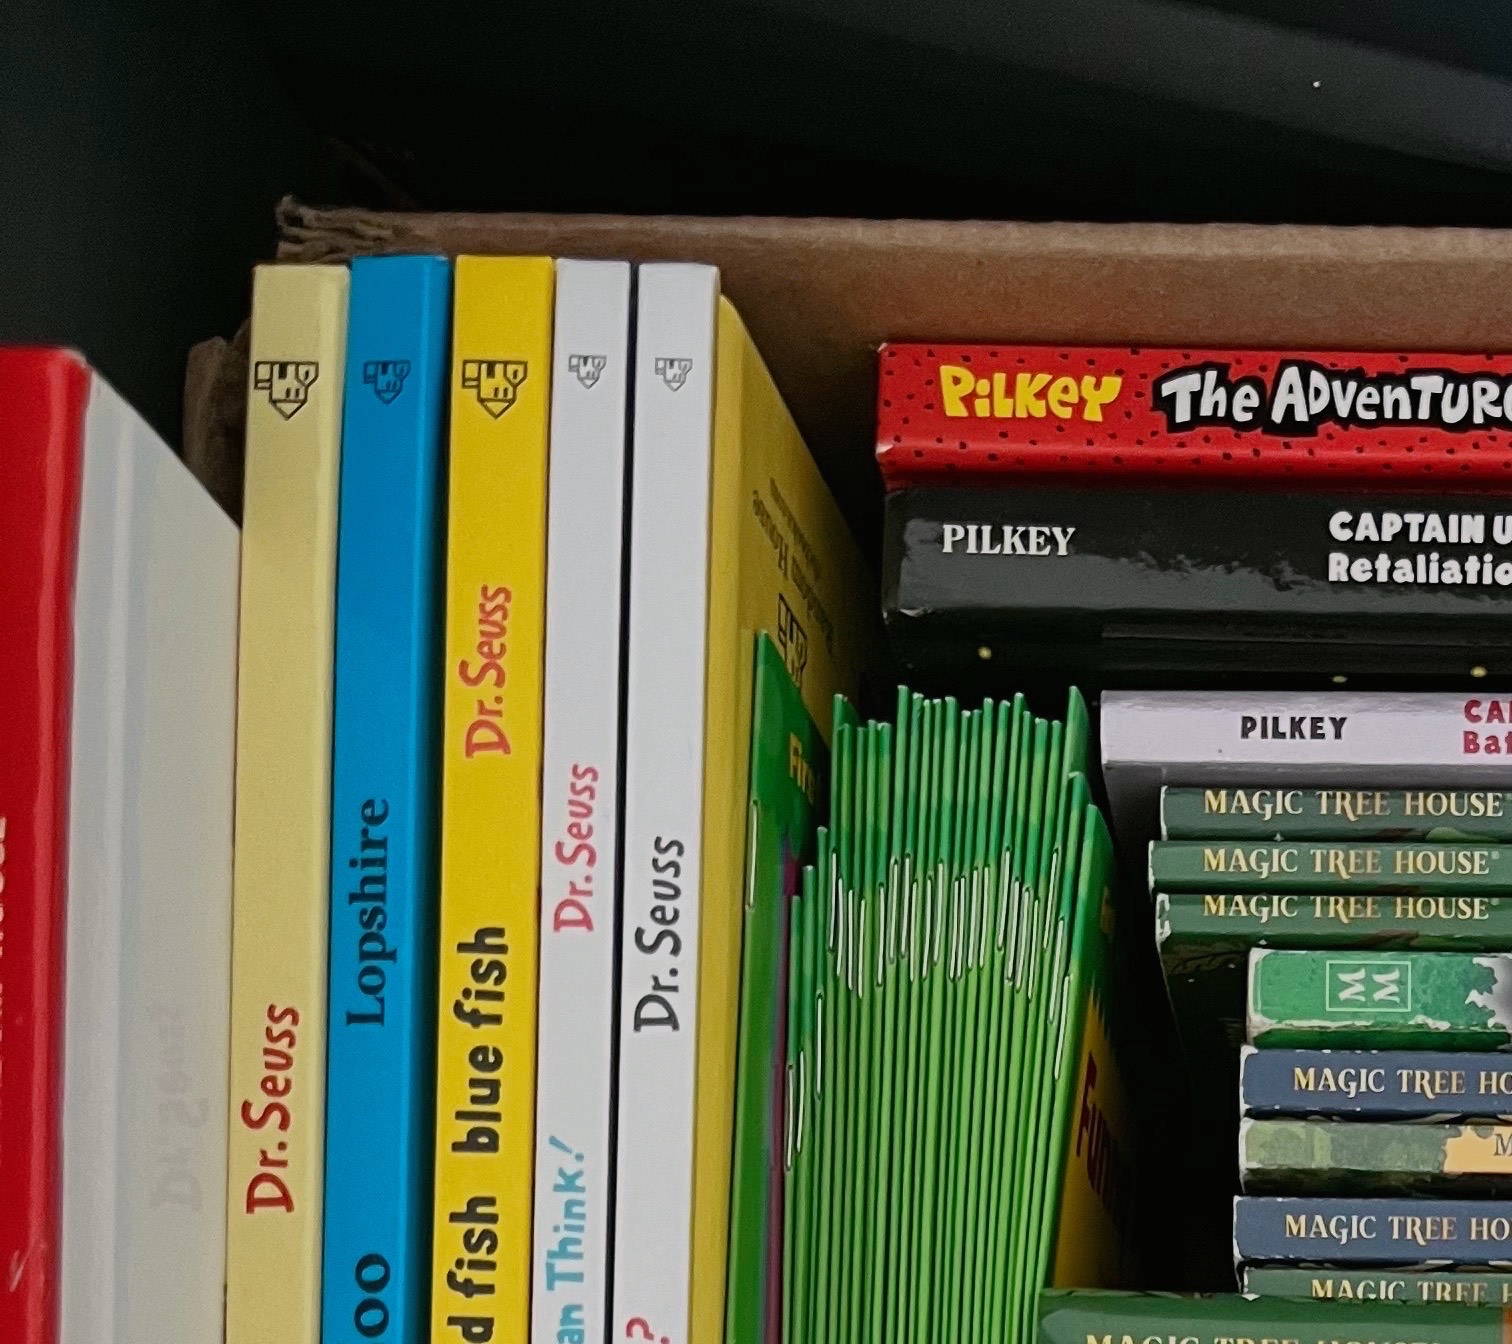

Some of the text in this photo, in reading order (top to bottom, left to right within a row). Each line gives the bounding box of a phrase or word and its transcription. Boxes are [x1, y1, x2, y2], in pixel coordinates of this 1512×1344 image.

[942, 524, 1076, 556] PILKEY
[1328, 511, 1482, 545] CAPTAIN
[1204, 790, 1303, 818] MAGIC
[1318, 792, 1391, 820] TREE
[347, 799, 397, 1026] Lopshire
[633, 836, 685, 1031] Dr. Seuss
[242, 1002, 300, 1215] Dr. Seuss
